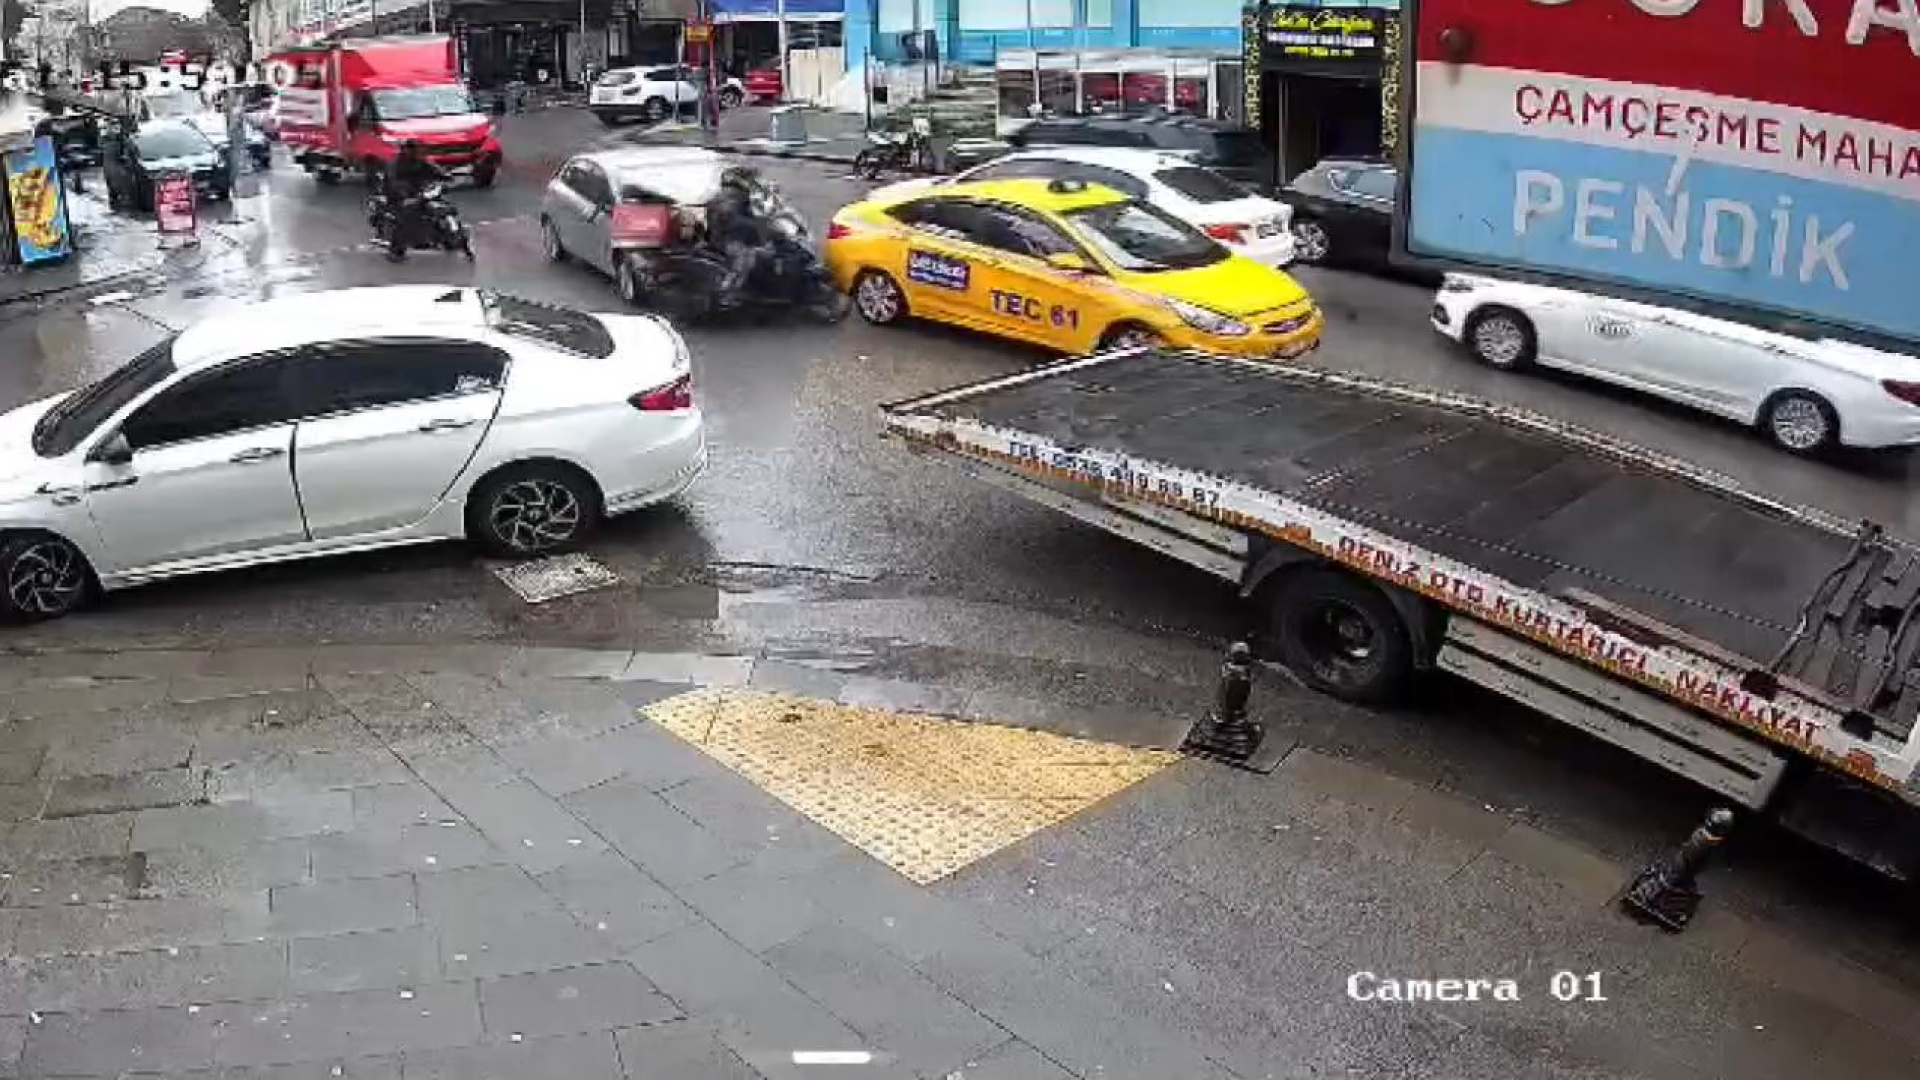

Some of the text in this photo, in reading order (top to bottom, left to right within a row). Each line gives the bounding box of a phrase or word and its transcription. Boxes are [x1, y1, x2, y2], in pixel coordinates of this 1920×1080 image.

[1514, 169, 1854, 291] PENDİK
[990, 288, 1080, 331] TEC 61
[1431, 572, 1484, 602] OTO
